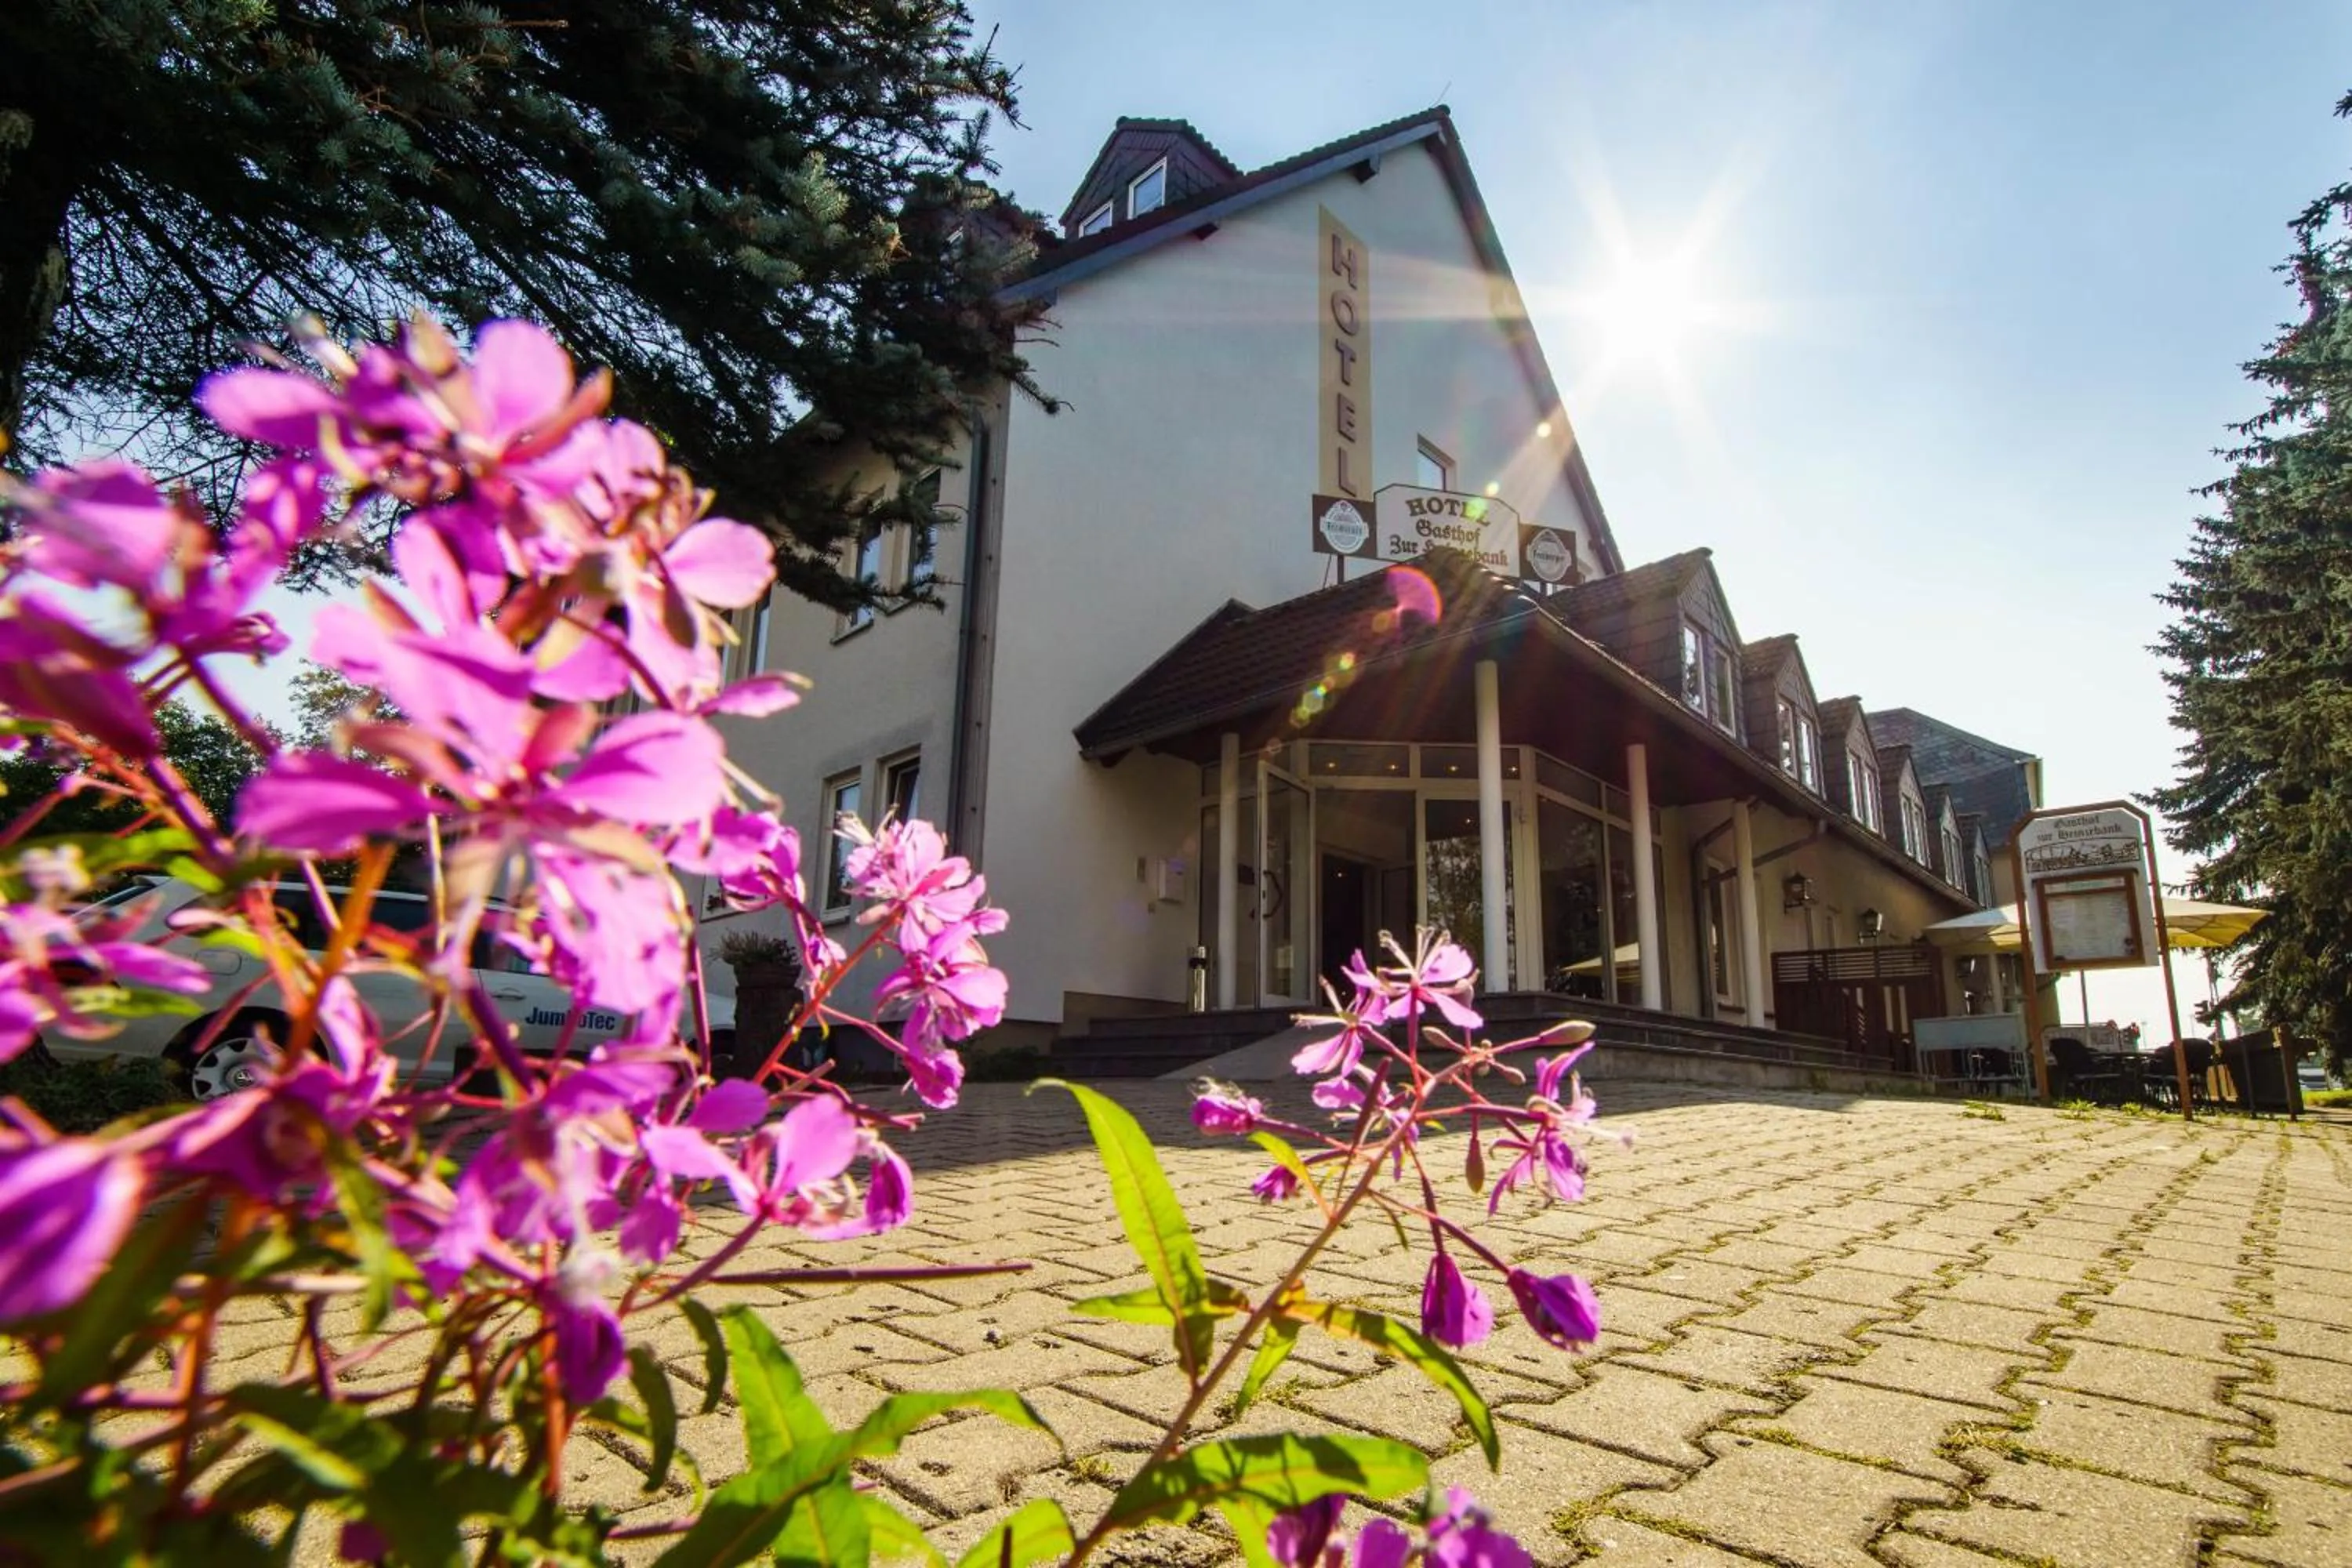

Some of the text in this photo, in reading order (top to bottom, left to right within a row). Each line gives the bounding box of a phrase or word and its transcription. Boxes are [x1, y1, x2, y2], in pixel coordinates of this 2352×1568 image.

[1331, 234, 1359, 497] HOTEL
[1389, 534, 1419, 555] Zur
[1415, 518, 1481, 550] Gasthof
[525, 1007, 615, 1030] JumoTec
